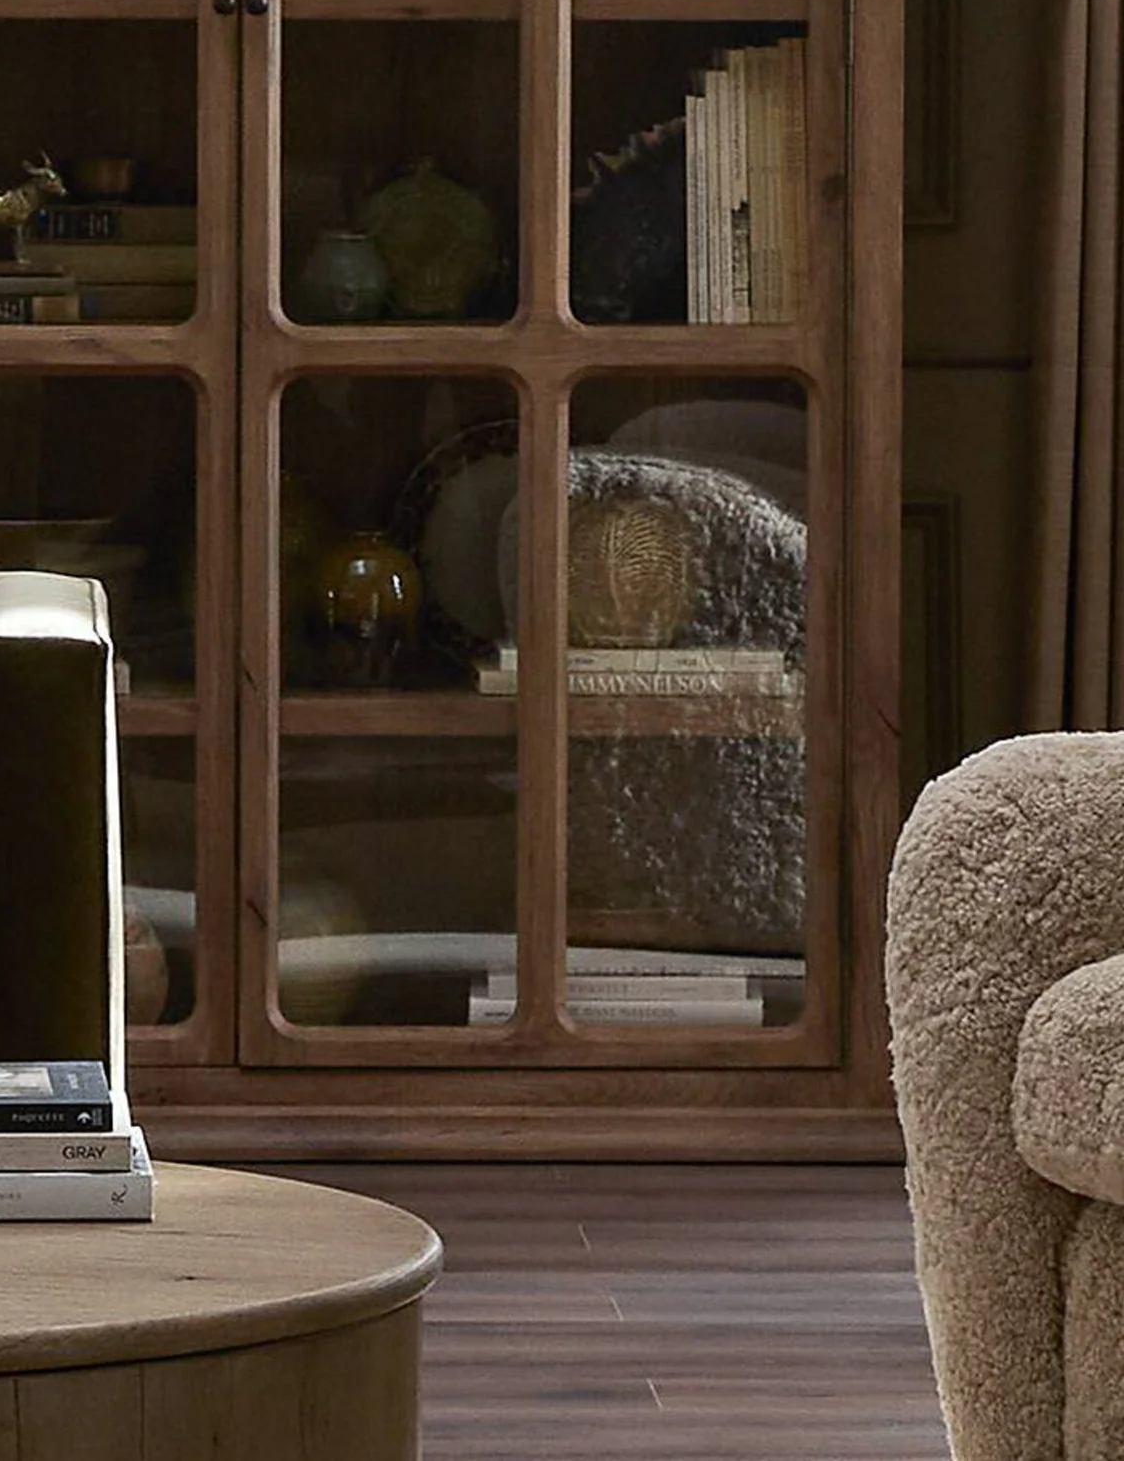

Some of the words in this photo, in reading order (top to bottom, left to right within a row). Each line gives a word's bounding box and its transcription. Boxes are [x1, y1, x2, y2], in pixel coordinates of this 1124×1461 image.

[569, 673, 627, 695] IMMY
[631, 673, 725, 696] NELSON
[62, 1145, 106, 1159] GRAY
